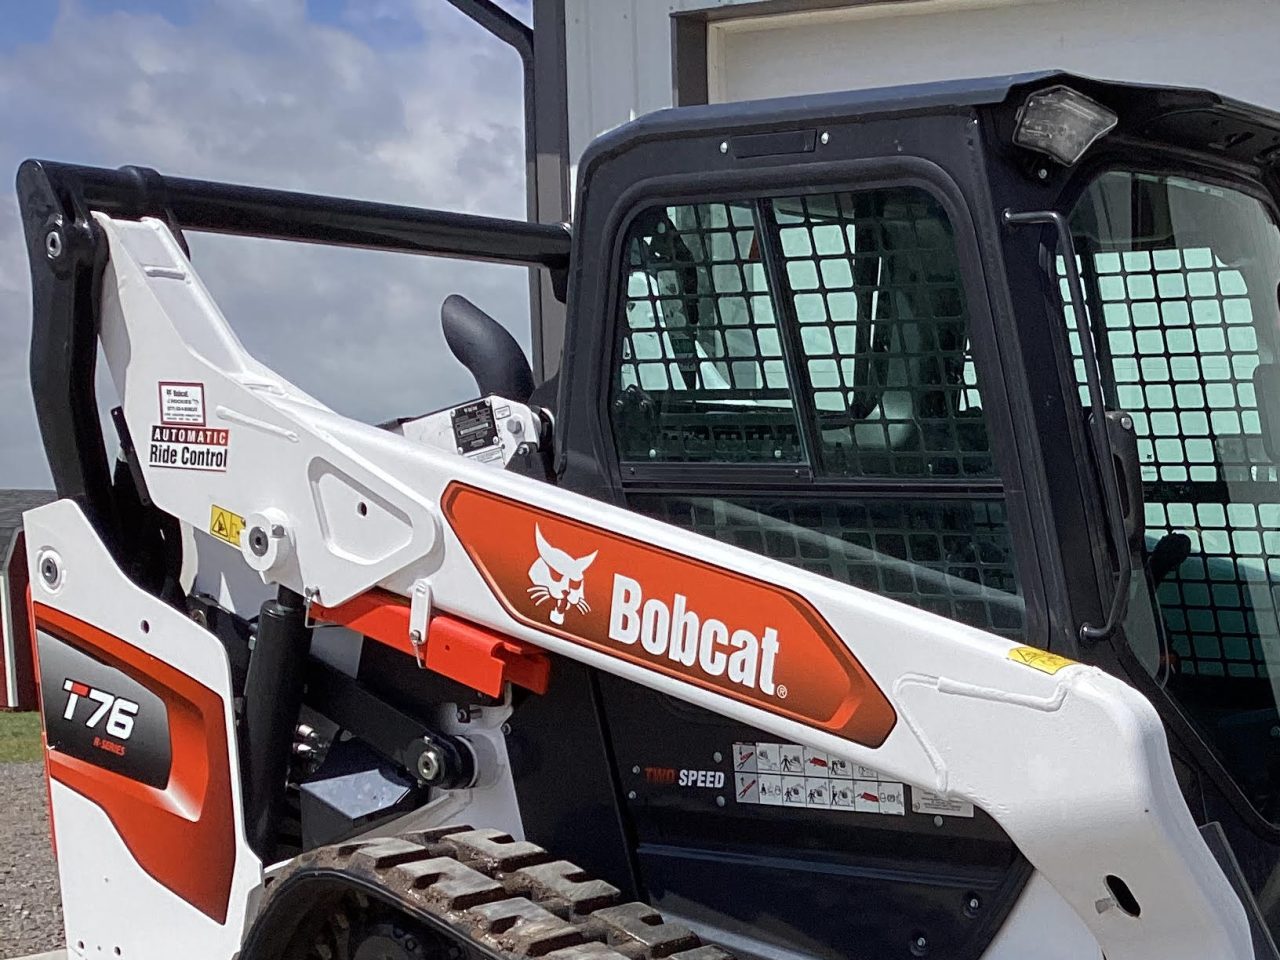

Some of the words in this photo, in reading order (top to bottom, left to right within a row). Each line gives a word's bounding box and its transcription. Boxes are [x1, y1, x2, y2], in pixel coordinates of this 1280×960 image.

[153, 428, 227, 445] AUTOMATIC
[149, 444, 177, 464] Ride
[181, 446, 228, 467] Control
[63, 679, 139, 740] T76
[678, 769, 725, 788] SPEED
